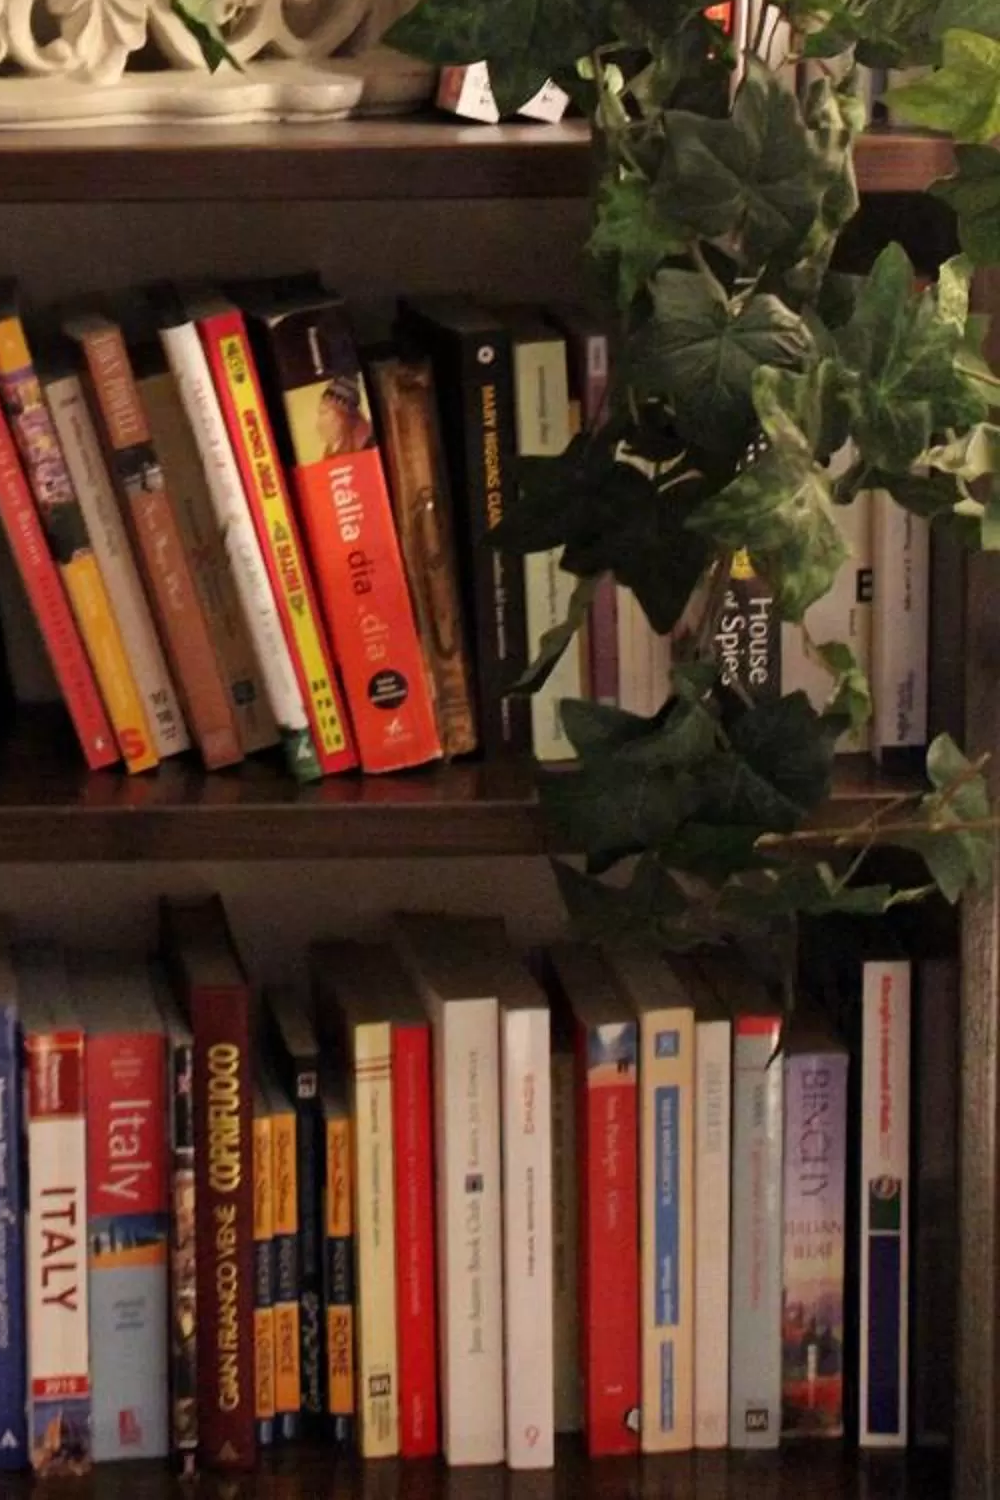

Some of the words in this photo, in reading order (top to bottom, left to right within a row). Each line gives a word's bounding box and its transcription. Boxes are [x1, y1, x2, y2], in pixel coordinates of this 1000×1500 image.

[326, 464, 361, 543] Itália
[345, 549, 375, 597] dia
[355, 615, 388, 662] dia
[714, 613, 745, 688] Spies
[747, 597, 773, 686] House
[98, 1100, 153, 1202] Italy
[208, 1042, 240, 1193] COPRIFUOCO
[798, 1067, 832, 1198] BINCHY
[38, 1186, 77, 1311] ITALY
[278, 1310, 295, 1375] VENICE
[331, 1313, 349, 1377] ROME
